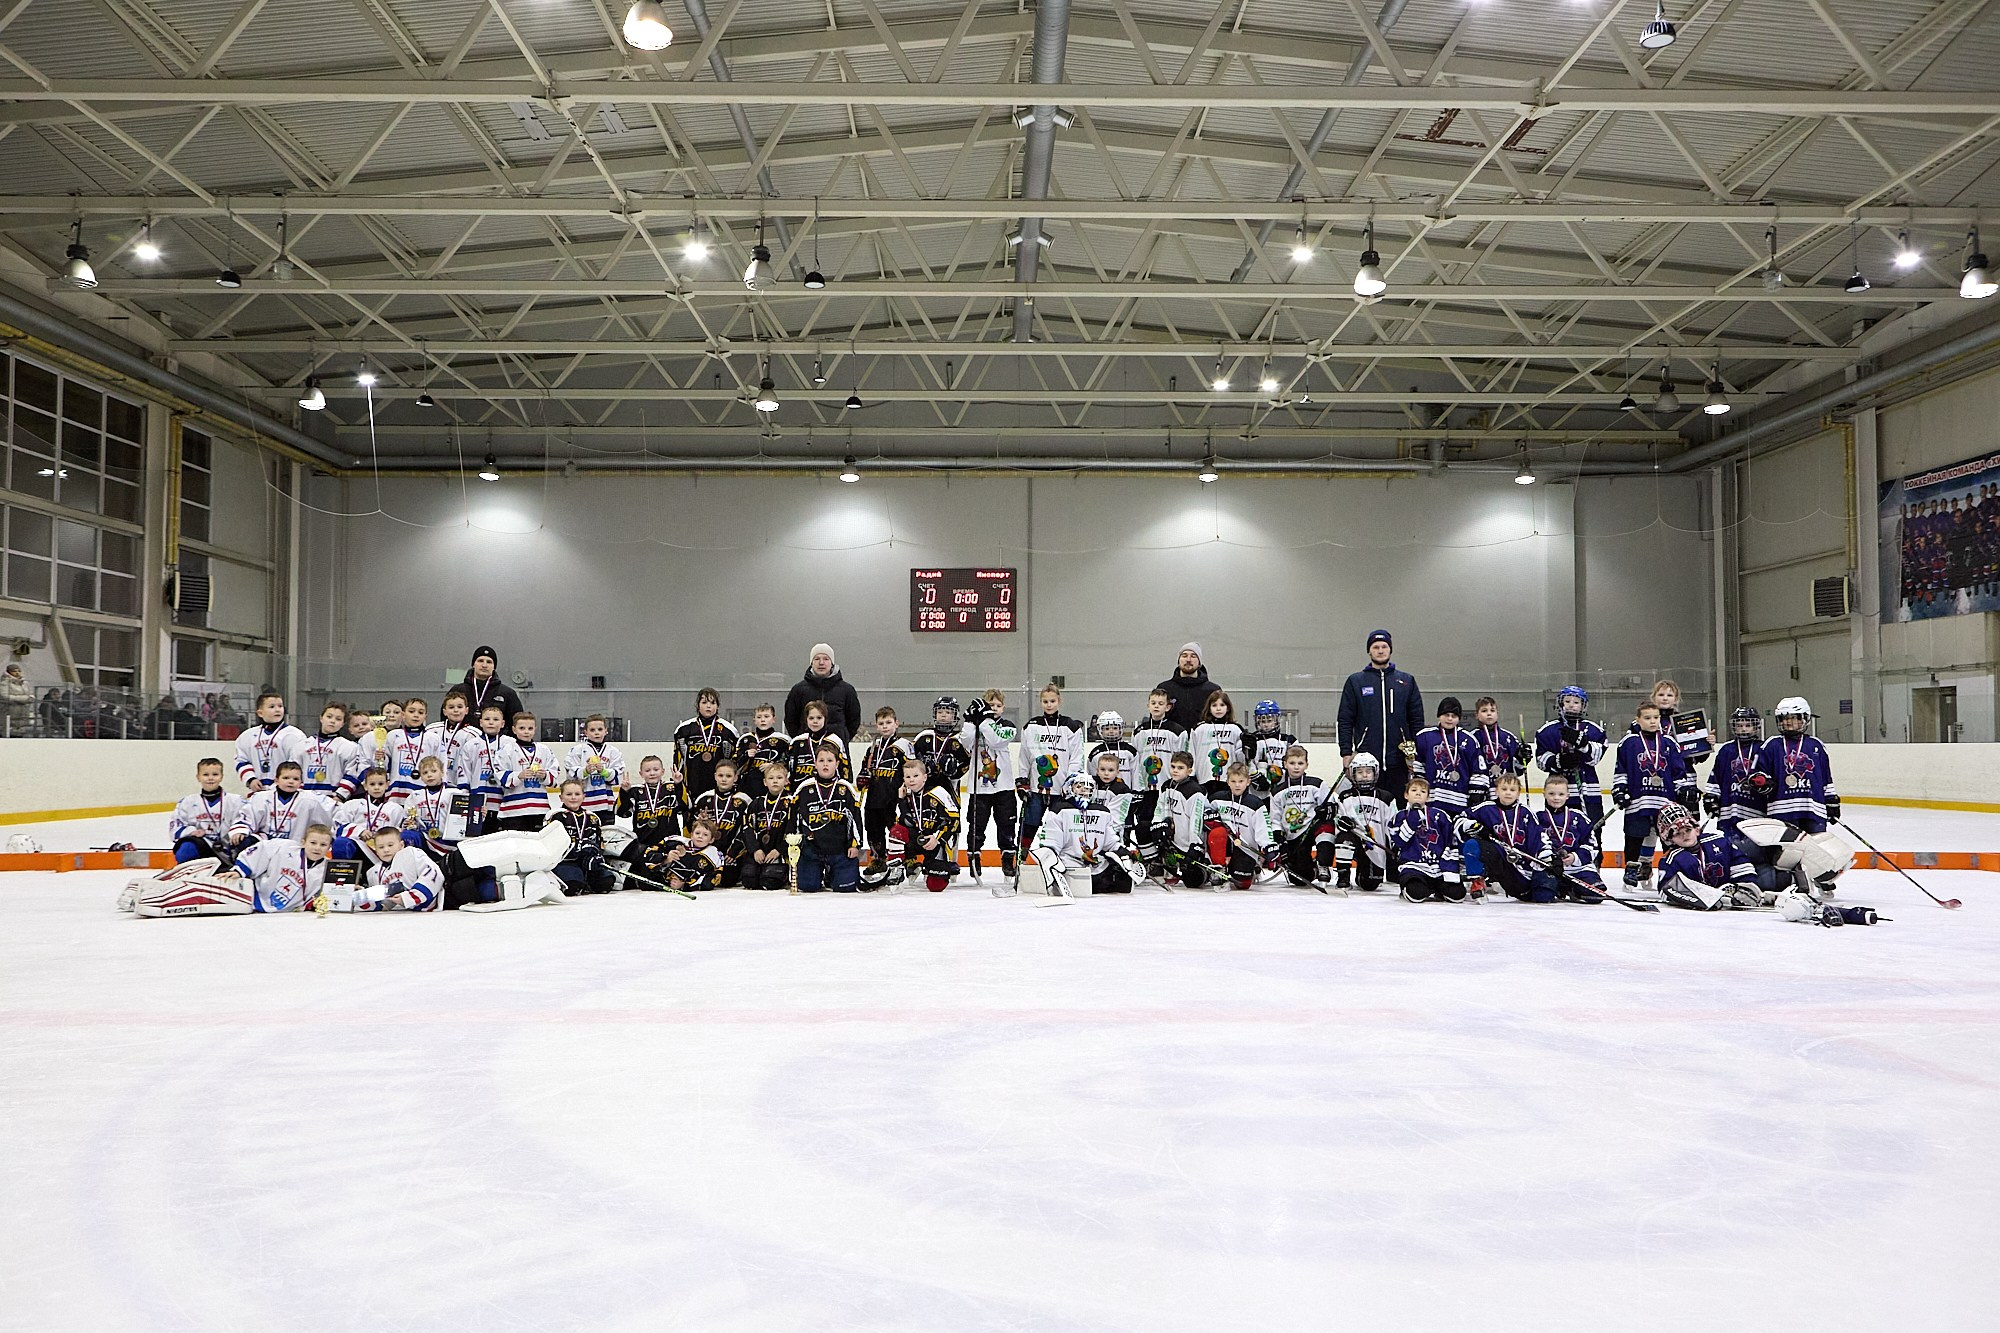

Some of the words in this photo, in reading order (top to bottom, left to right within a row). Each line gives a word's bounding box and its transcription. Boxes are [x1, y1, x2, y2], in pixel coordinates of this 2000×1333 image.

[1904, 471, 1947, 489] ХОККЕЙНАЯ
[1947, 461, 1985, 479] КОМАНДА
[925, 588, 936, 604] 0
[954, 593, 979, 604] 0:00
[999, 588, 1011, 604] 0
[928, 612, 946, 620] 0:00
[959, 611, 967, 623] 0
[993, 612, 1011, 620] 0:00
[928, 621, 946, 629] 0:00
[993, 621, 1011, 629] 0:00
